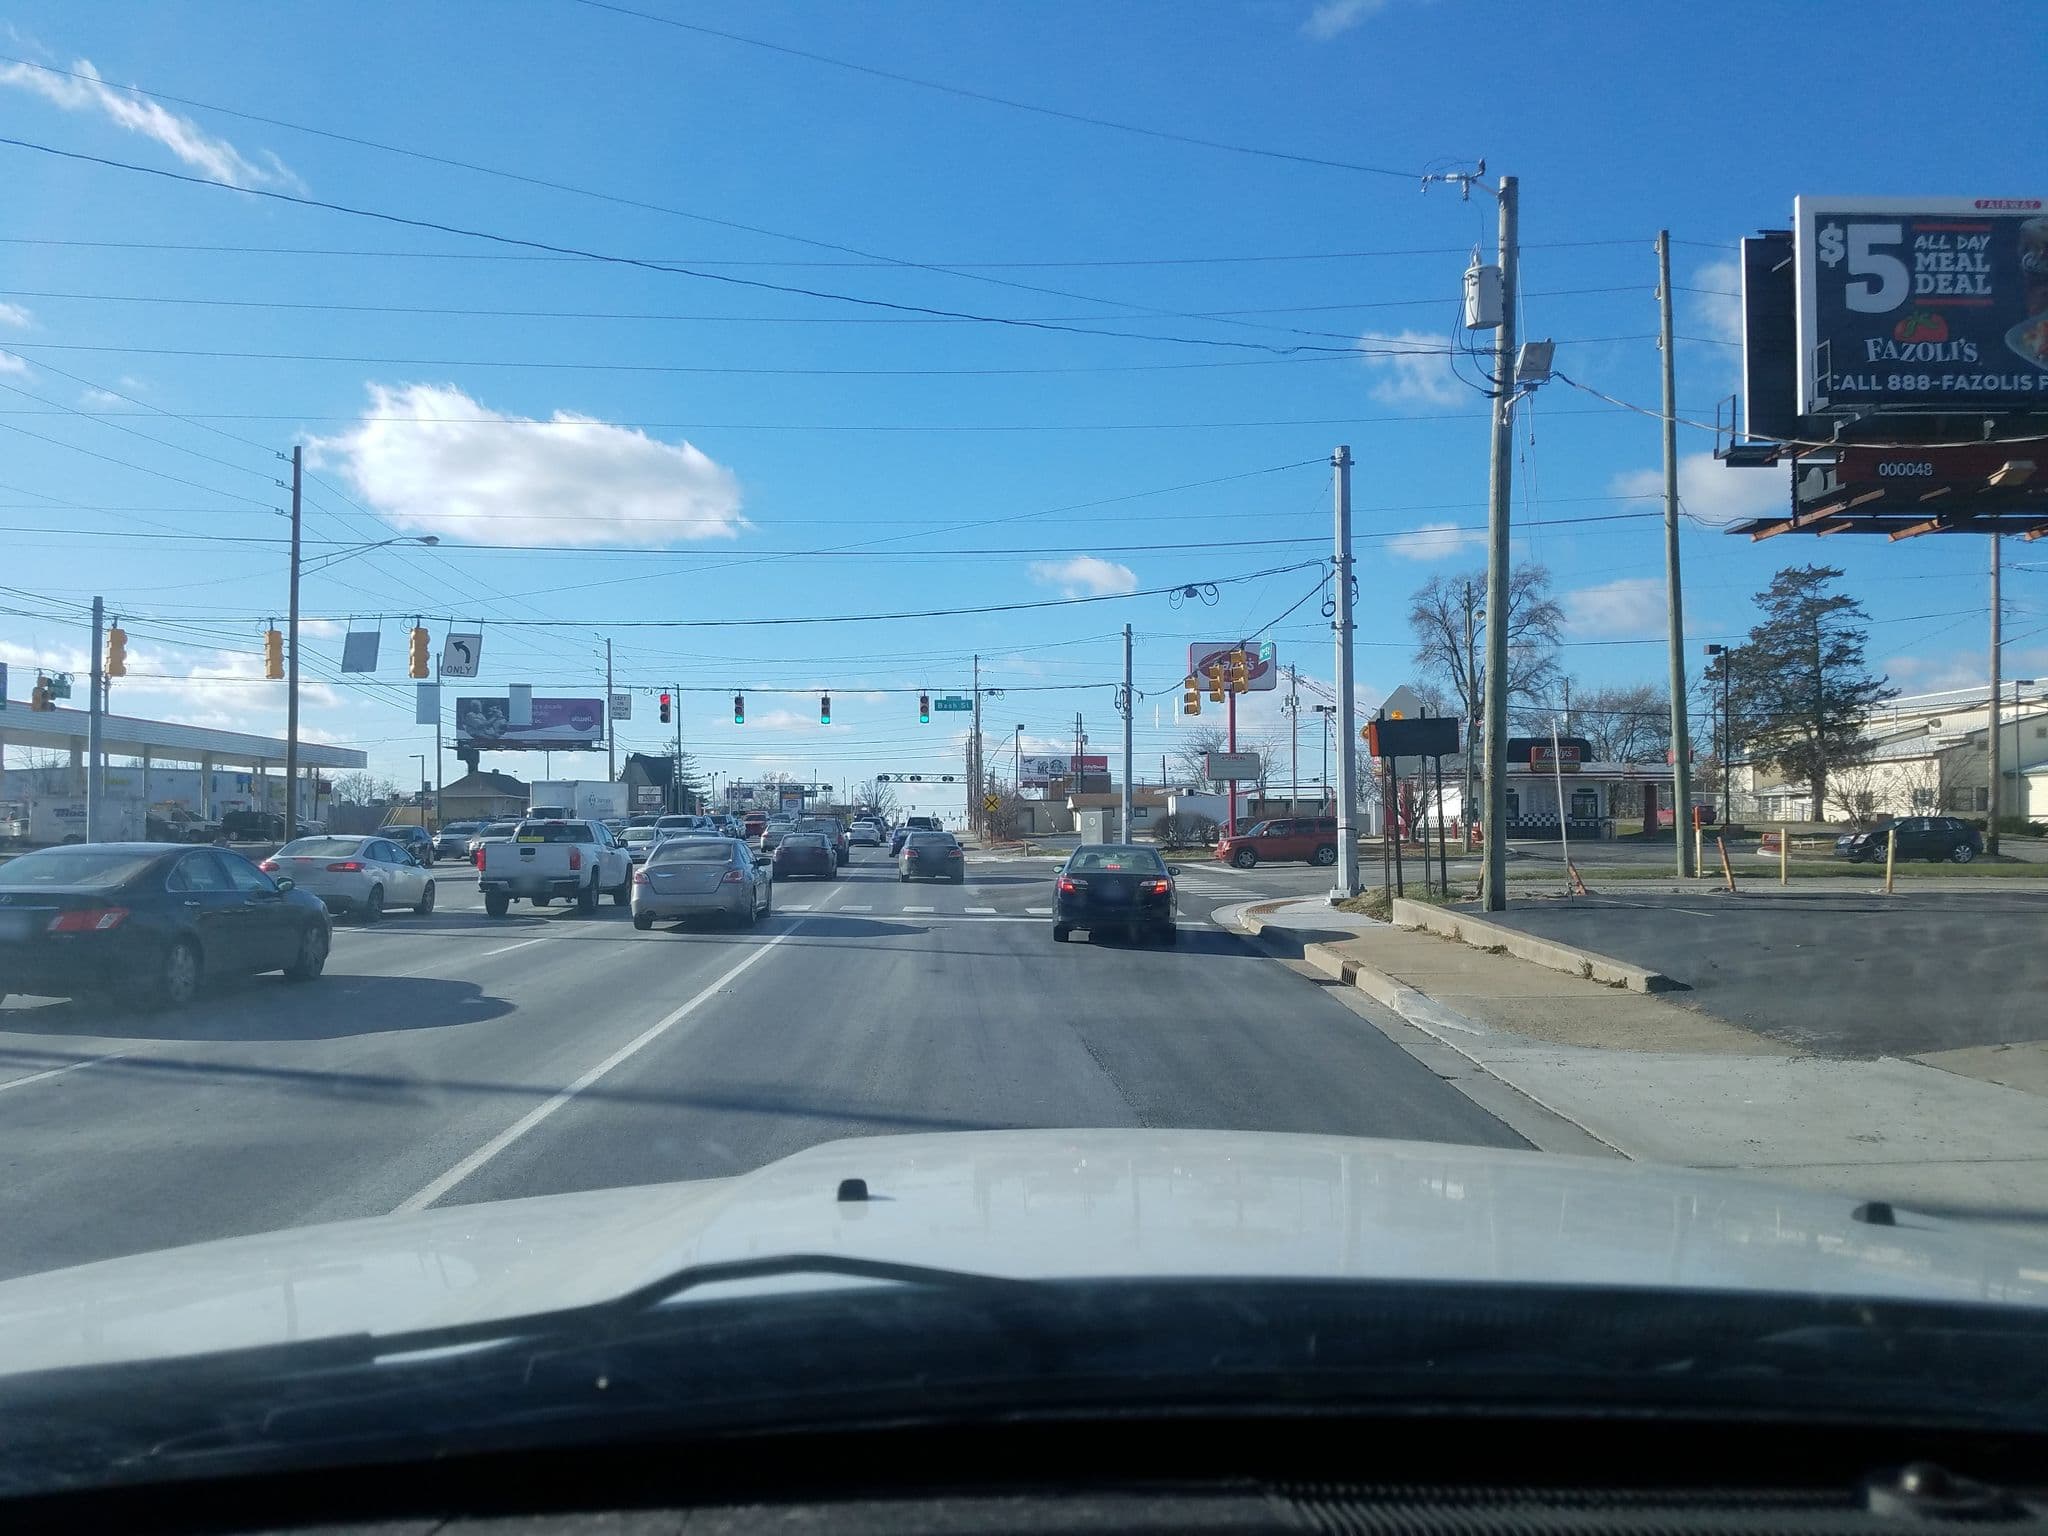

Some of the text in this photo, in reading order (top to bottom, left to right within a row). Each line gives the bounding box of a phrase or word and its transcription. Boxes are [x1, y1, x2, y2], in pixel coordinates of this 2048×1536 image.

[1980, 200, 2036, 209] FAIRWAY
[1914, 235, 1991, 251] ALL DAY
[1914, 252, 1991, 273] MEAL
[1914, 273, 1993, 295] DEAL
[1864, 337, 1980, 363] FAZOLI'S
[1887, 374, 2034, 391] 888-FAZOLIS
[1878, 463, 1933, 477] 000048
[446, 665, 472, 675] ONLY
